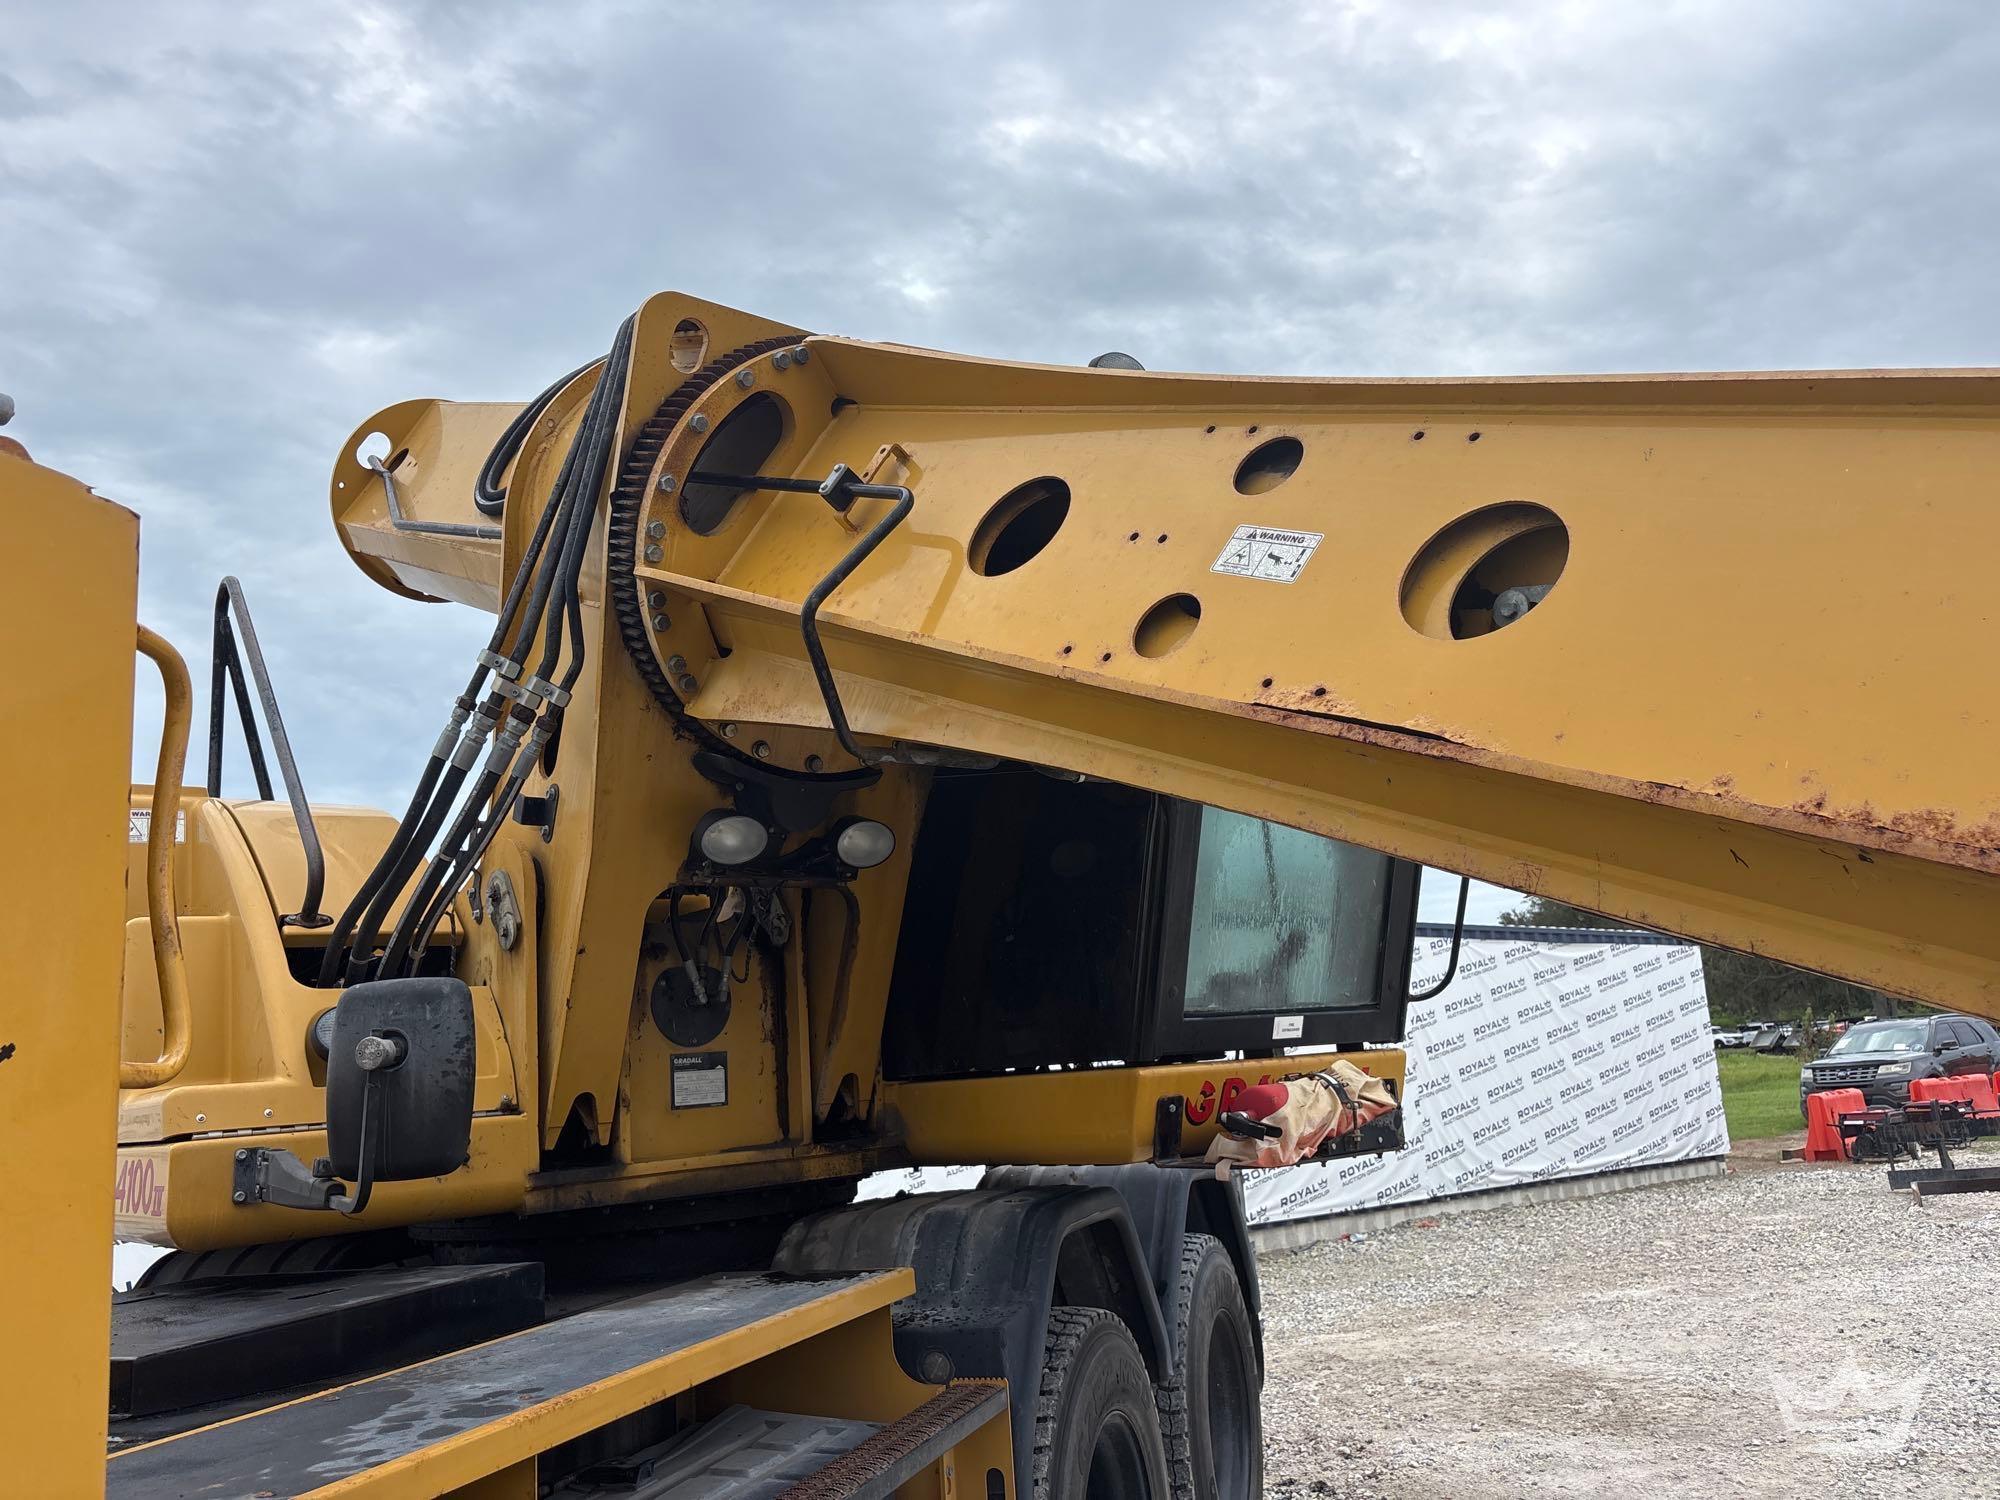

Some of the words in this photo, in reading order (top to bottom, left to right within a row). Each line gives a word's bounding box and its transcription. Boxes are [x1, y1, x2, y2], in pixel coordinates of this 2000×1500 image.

[1259, 532, 1305, 544] WARNING
[1504, 944, 1532, 959] ROYAL
[1573, 953, 1596, 966] ROYAL
[1666, 947, 1689, 960] ROYAL
[1460, 958, 1488, 974] ROYAL
[1534, 966, 1559, 980] ROYAL
[1633, 960, 1654, 973] ROYAL
[1412, 973, 1442, 990] ROYAL
[1491, 980, 1518, 997] ROYAL
[1597, 974, 1620, 988] ROYAL
[1658, 979, 1680, 992] ROYAL
[1559, 988, 1583, 1002] ROYAL
[1623, 992, 1647, 1007] ROYAL
[1445, 996, 1474, 1013] ROYAL
[1518, 1003, 1545, 1019] ROYAL
[1680, 999, 1700, 1012] ROYAL
[1586, 1008, 1610, 1023] ROYAL
[1646, 1013, 1670, 1027] ROYAL
[1474, 1019, 1502, 1036] ROYAL
[1547, 1024, 1572, 1039] ROYAL
[1611, 1028, 1636, 1043] ROYAL
[1426, 1037, 1457, 1055] ROYAL
[1671, 1032, 1692, 1046] ROYAL
[1504, 1041, 1532, 1058] ROYAL
[1572, 1044, 1597, 1060] ROYAL
[1636, 1047, 1659, 1063] ROYAL
[1692, 1051, 1713, 1065] ROYAL
[1459, 1059, 1488, 1076] ROYAL
[1531, 1062, 1557, 1079] ROYAL
[1600, 1064, 1624, 1080] ROYAL
[1659, 1066, 1680, 1082] ROYAL
[1488, 1081, 1516, 1099] ROYAL
[1560, 1082, 1586, 1099] ROYAL
[1624, 1084, 1646, 1100] ROYAL
[1684, 1085, 1705, 1100] ROYAL
[1441, 1102, 1471, 1120] ROYAL
[1518, 1101, 1545, 1119] ROYAL
[1585, 1102, 1610, 1119] ROYAL
[1649, 1102, 1672, 1118] ROYAL
[1473, 1122, 1502, 1140] ROYAL
[1545, 1122, 1571, 1140] ROYAL
[1612, 1122, 1637, 1138] ROYAL
[1673, 1121, 1694, 1137] ROYAL
[1425, 1144, 1457, 1162] ROYAL
[1502, 1143, 1530, 1162] ROYAL
[1574, 1140, 1599, 1159] ROYAL
[1638, 1140, 1661, 1156] ROYAL
[1340, 1158, 1375, 1180] ROYAL
[1456, 1166, 1485, 1185] ROYAL
[1280, 1184, 1318, 1207] ROYAL
[1377, 1180, 1411, 1200] ROYAL
